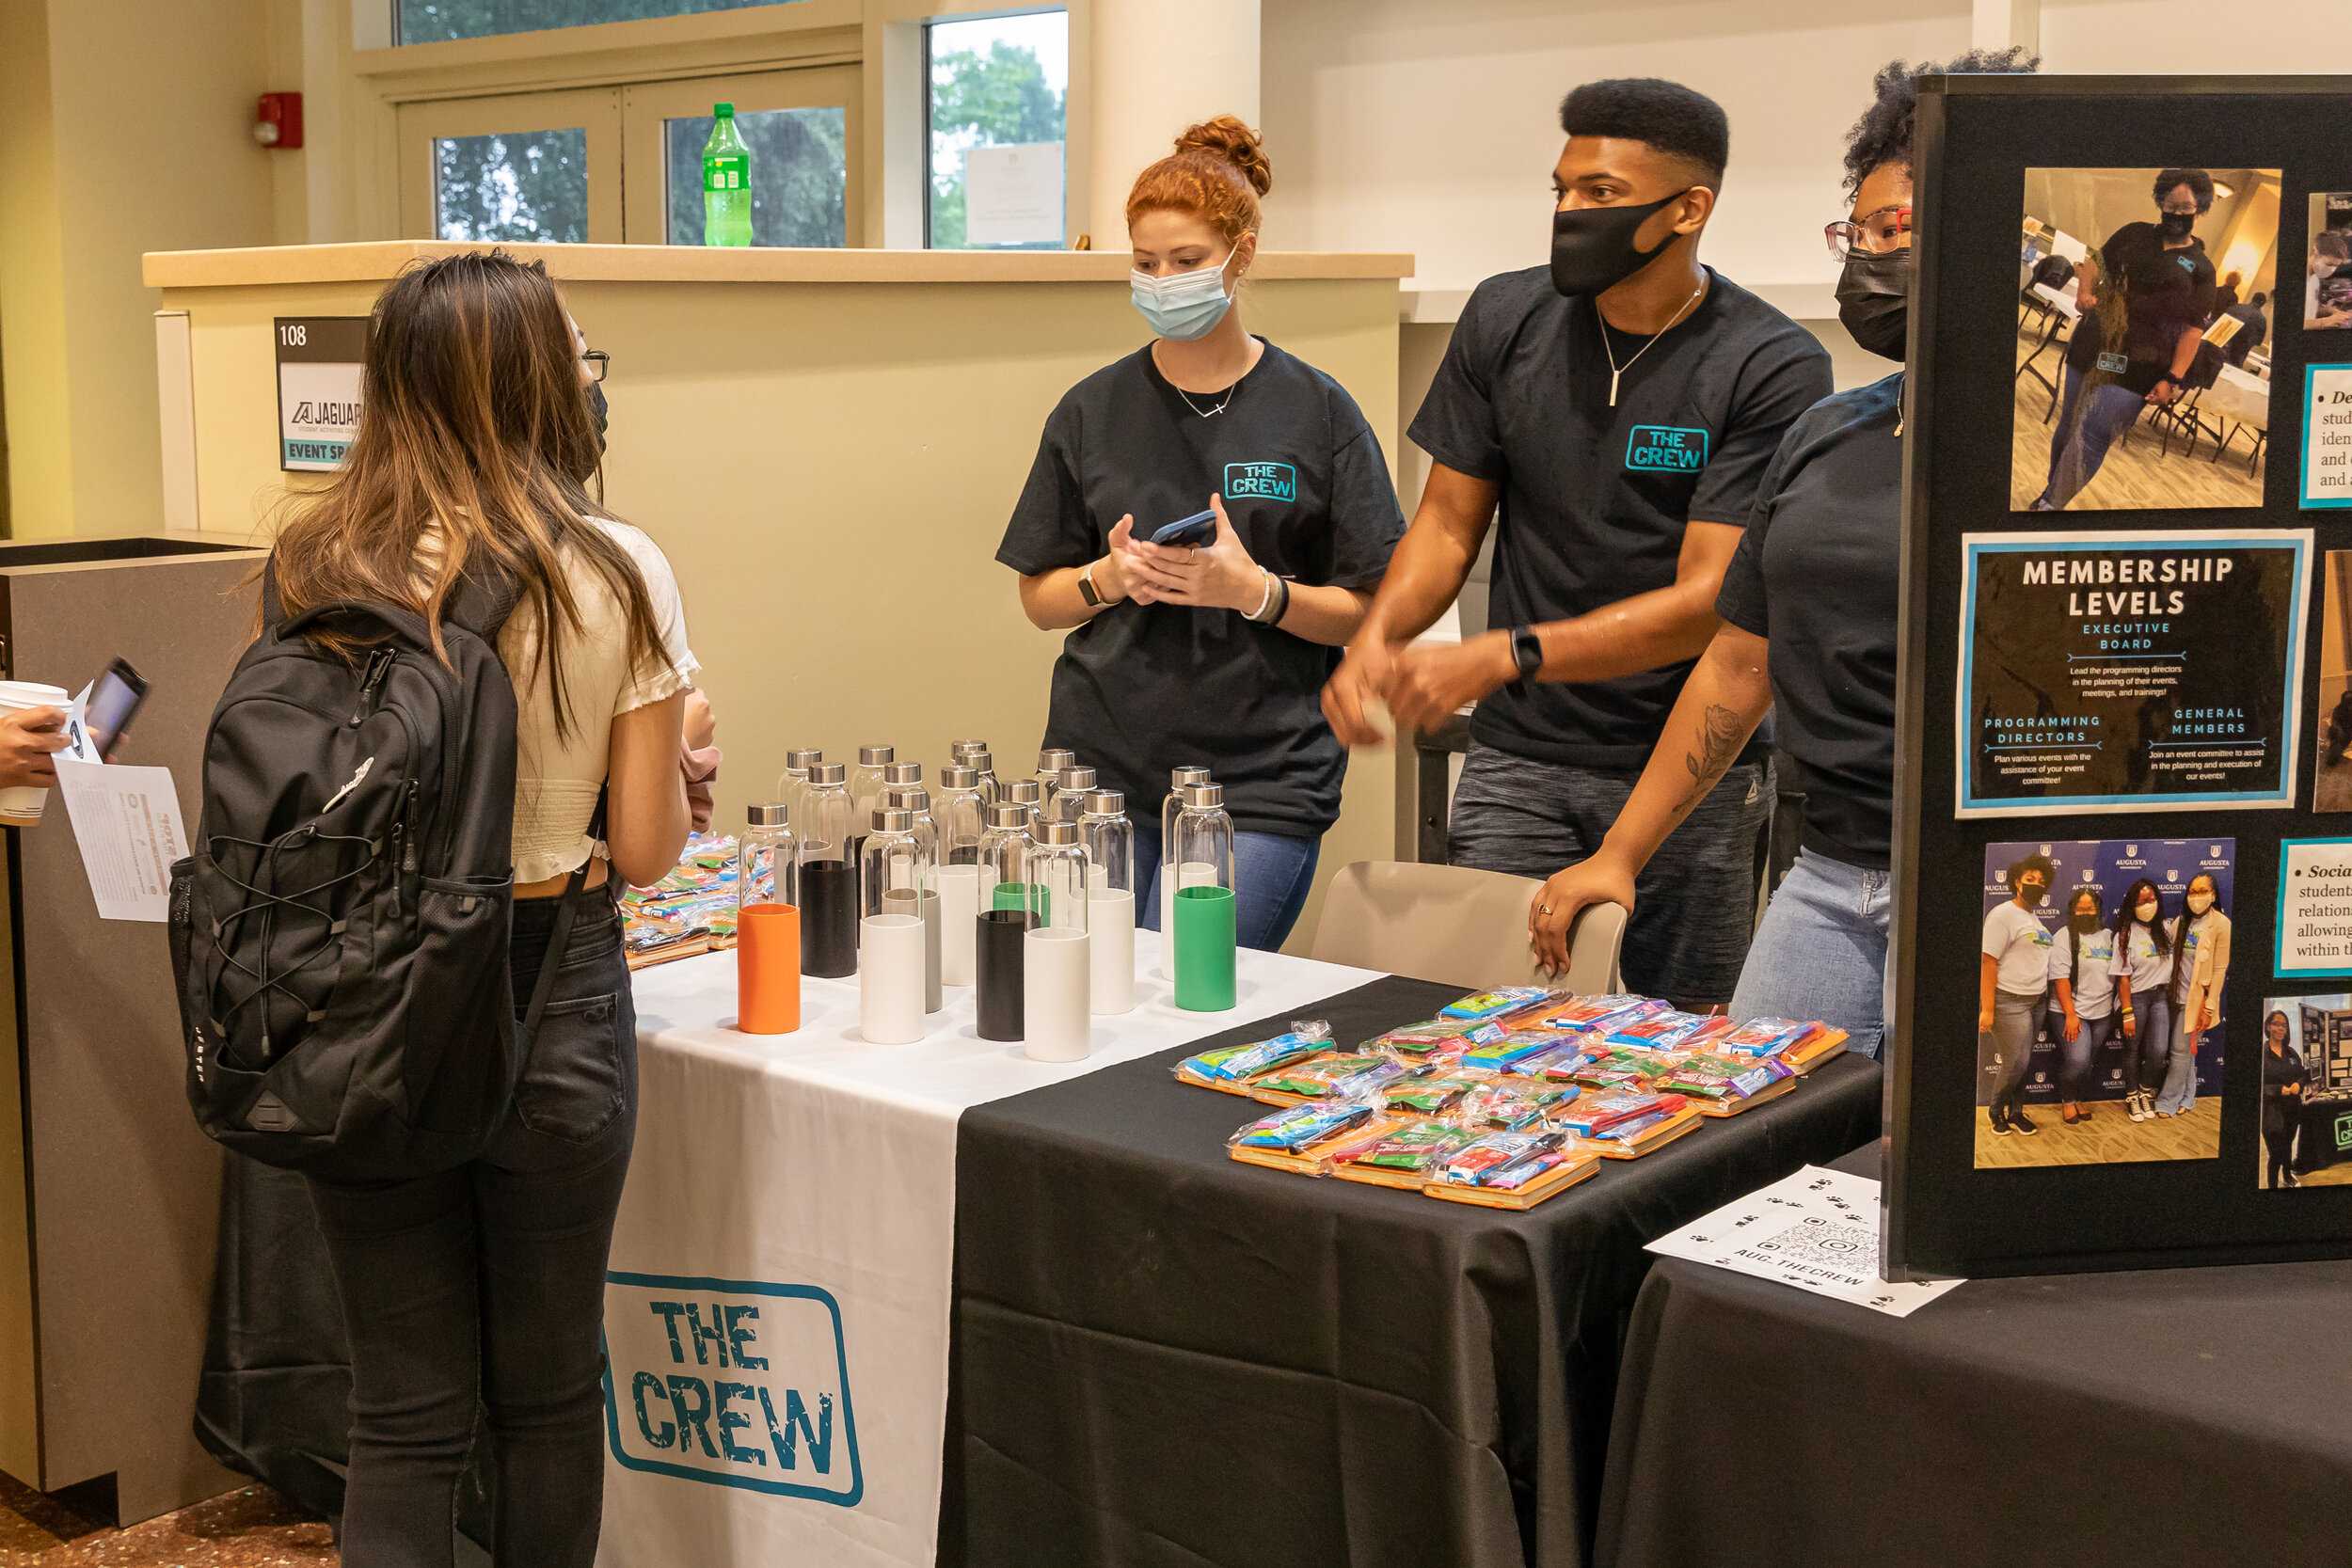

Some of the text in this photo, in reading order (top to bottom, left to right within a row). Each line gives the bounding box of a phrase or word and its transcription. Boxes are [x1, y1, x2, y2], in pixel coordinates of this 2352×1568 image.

[279, 325, 307, 346] 108
[1650, 431, 1686, 448] THE
[289, 443, 345, 460] EVENT SP
[1634, 447, 1700, 468] CREW
[2321, 451, 2346, 467] and
[1244, 466, 1278, 478] THE
[2320, 472, 2345, 486] and
[1232, 478, 1291, 497] CREW
[2023, 558, 2233, 585] MEMBERSHIP
[2069, 591, 2185, 616] LEVELS
[2083, 623, 2169, 634] EXECUTIVE
[2100, 639, 2152, 649] BOARD
[2070, 667, 2089, 675] Lead
[2103, 666, 2150, 676] programming
[2152, 665, 2183, 673] directors
[2093, 677, 2124, 687] planning
[2174, 708, 2244, 719] GENERAL
[1984, 717, 2100, 728] PROGRAMMING
[2171, 723, 2245, 734] MEMBERS
[1997, 732, 2085, 743] DIRECTORS
[1994, 754, 2010, 763] Plan
[2149, 751, 2164, 759] Join
[2046, 766, 2062, 774] your
[2171, 761, 2202, 770] planning
[2218, 760, 2252, 768] execution
[2308, 863, 2352, 879] Socia
[2296, 942, 2340, 957] within
[649, 1301, 770, 1371] THE
[631, 1370, 833, 1474] CREW
